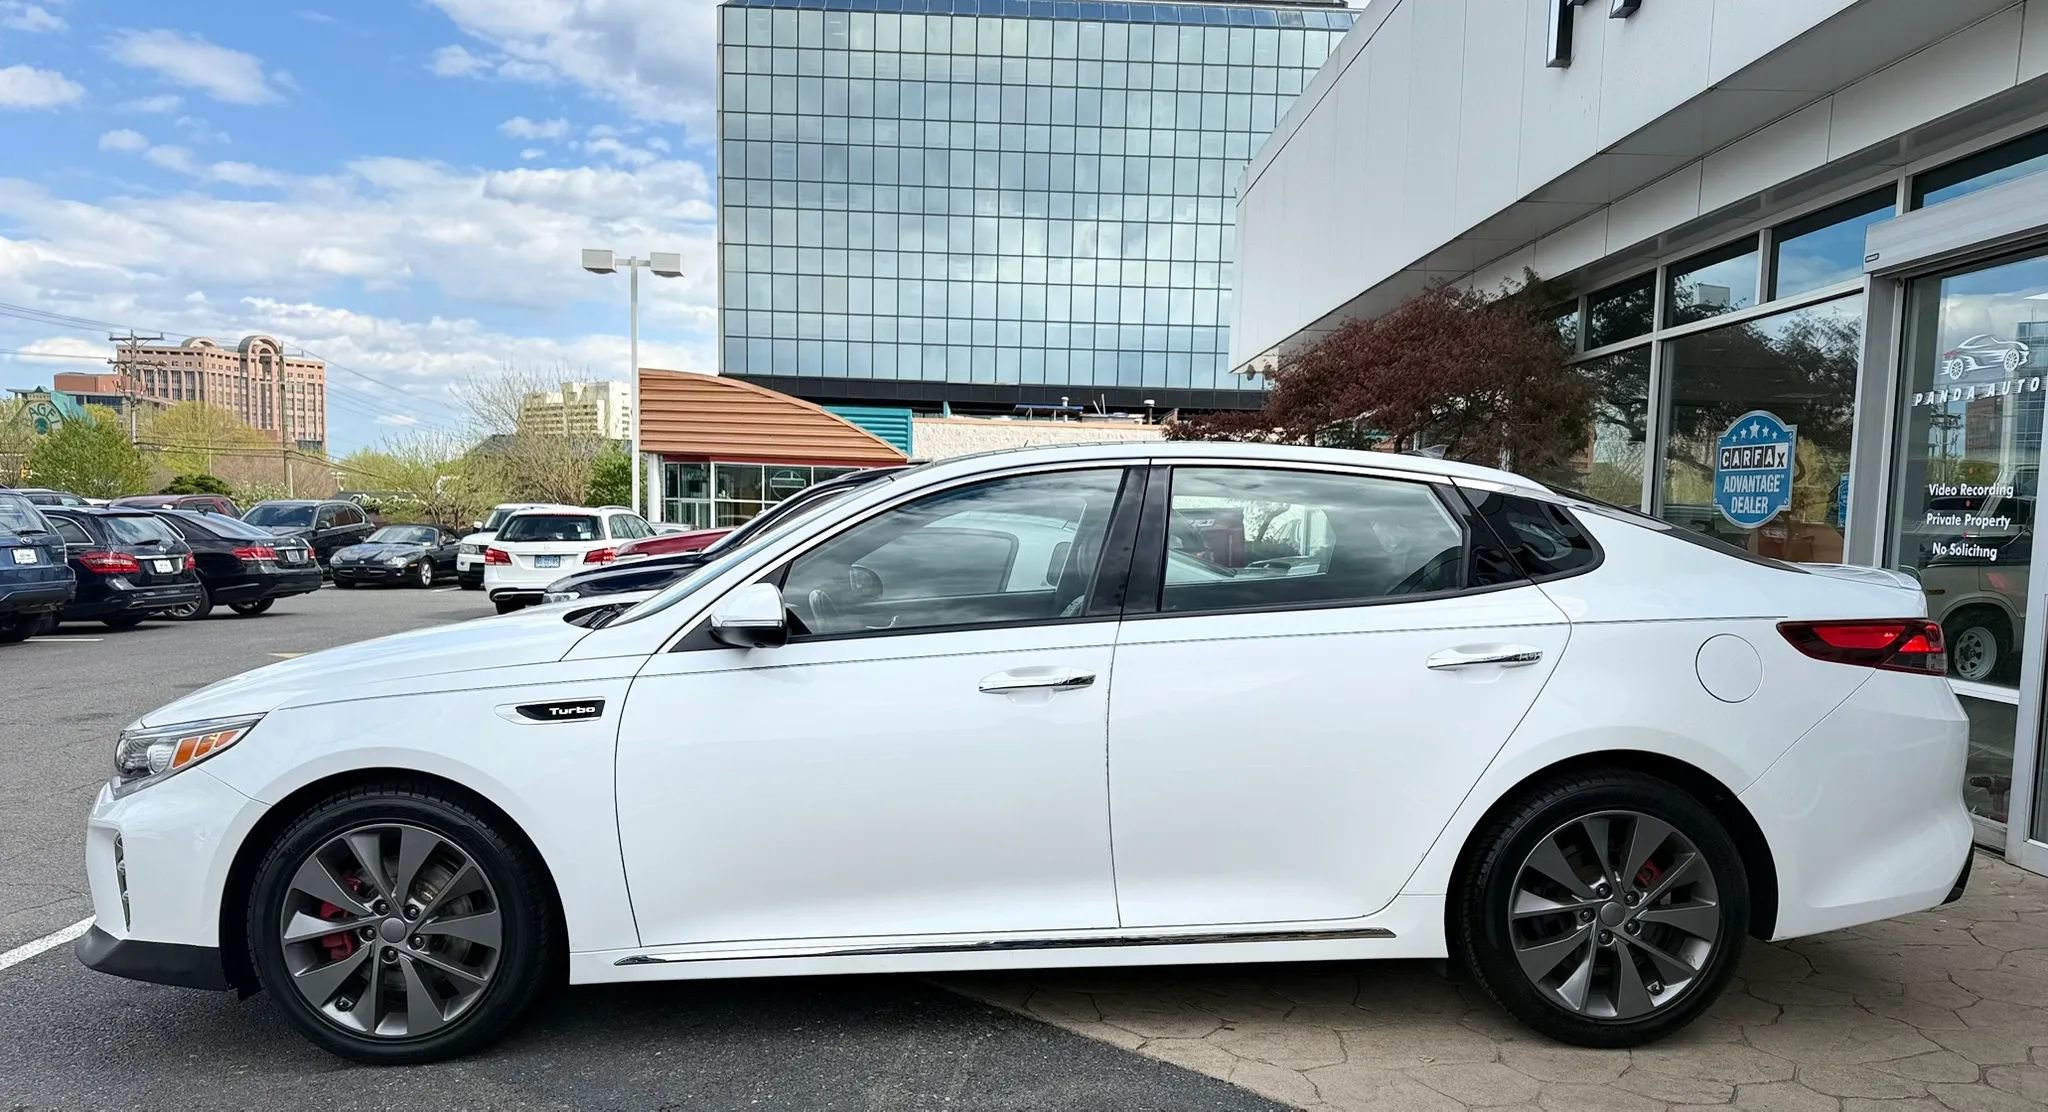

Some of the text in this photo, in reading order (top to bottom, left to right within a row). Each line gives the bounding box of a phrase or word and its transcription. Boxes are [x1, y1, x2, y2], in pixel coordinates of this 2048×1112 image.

[1912, 377, 2040, 406] PANDA AUTO
[1721, 446, 1786, 469] CARFAX
[1723, 475, 1780, 494] ADVANTAGE
[1928, 482, 2014, 499] Video Recording
[1731, 496, 1769, 514] DEALER
[1926, 513, 2011, 530] Private Property
[1932, 542, 1998, 561] No Soliciting
[549, 706, 596, 715] Turbo
